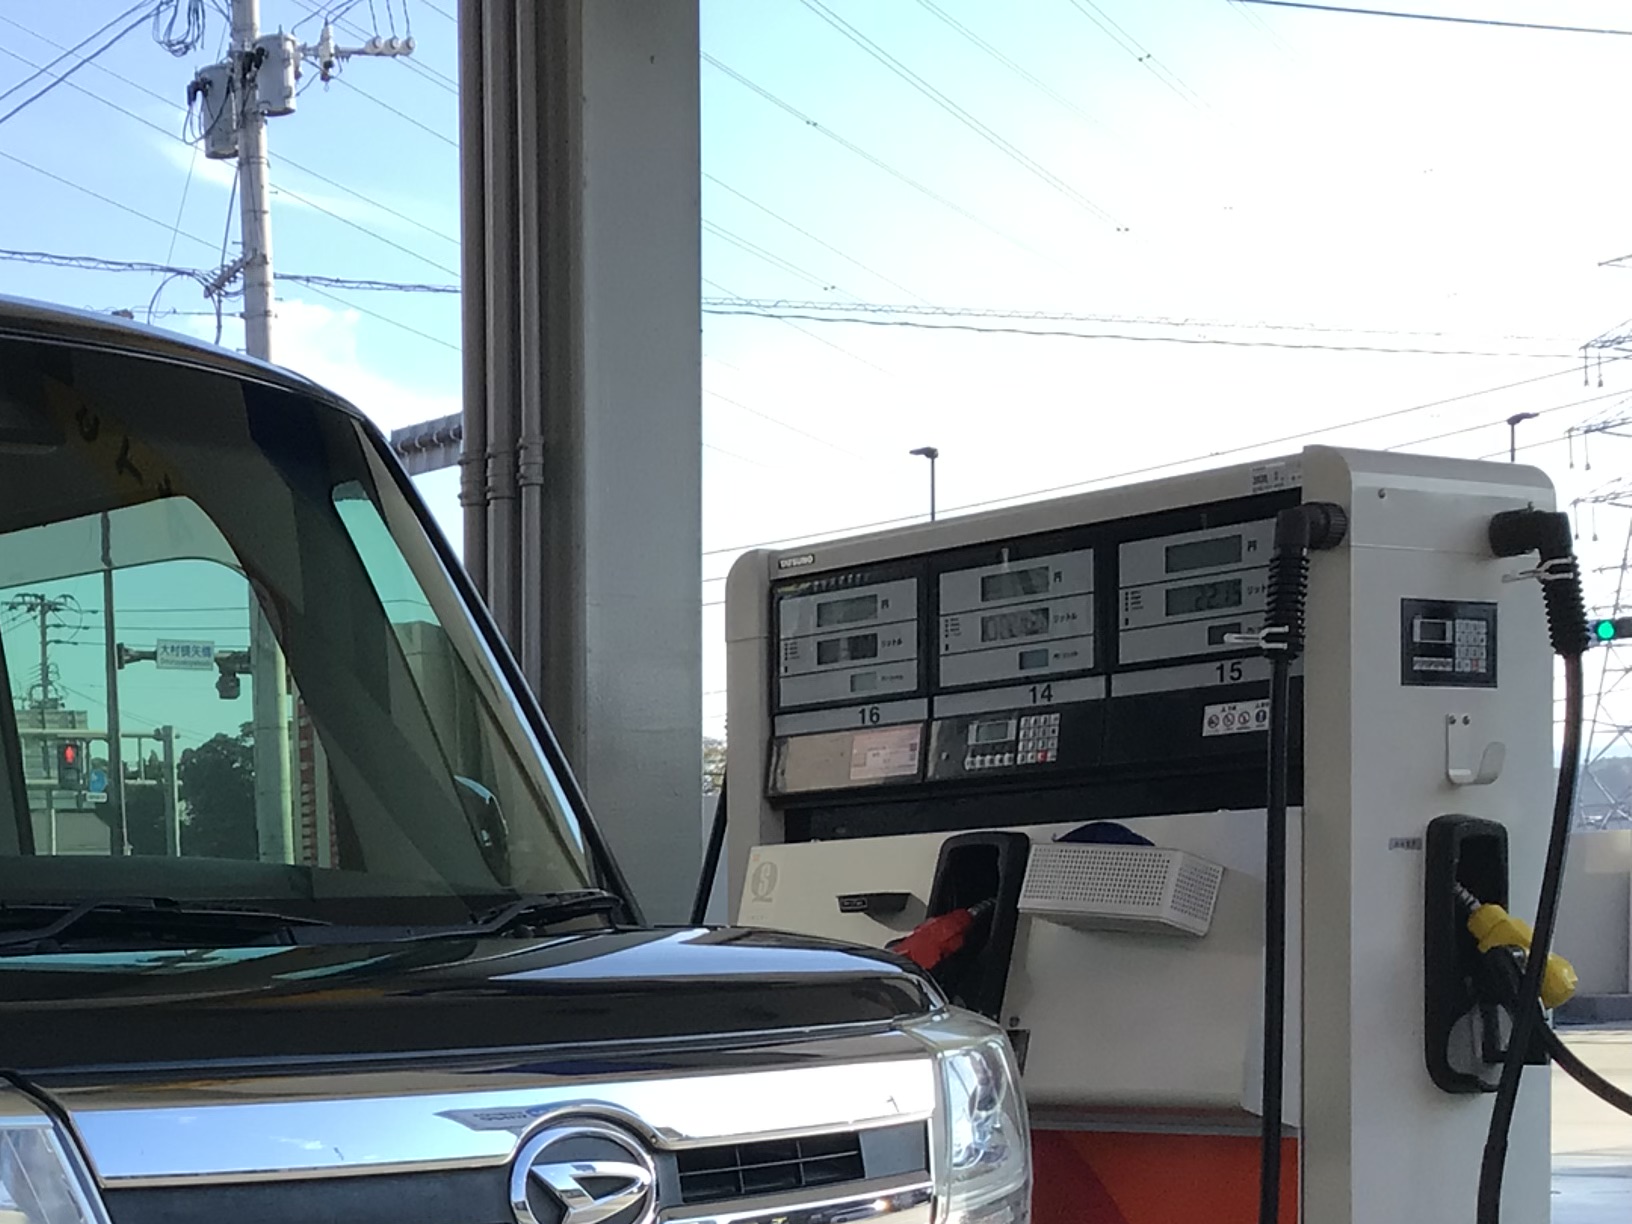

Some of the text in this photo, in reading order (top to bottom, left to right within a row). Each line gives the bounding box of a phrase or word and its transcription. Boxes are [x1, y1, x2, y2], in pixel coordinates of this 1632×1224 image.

[1216, 661, 1242, 683] 15
[1029, 684, 1053, 704] 14
[859, 706, 880, 725] 16
